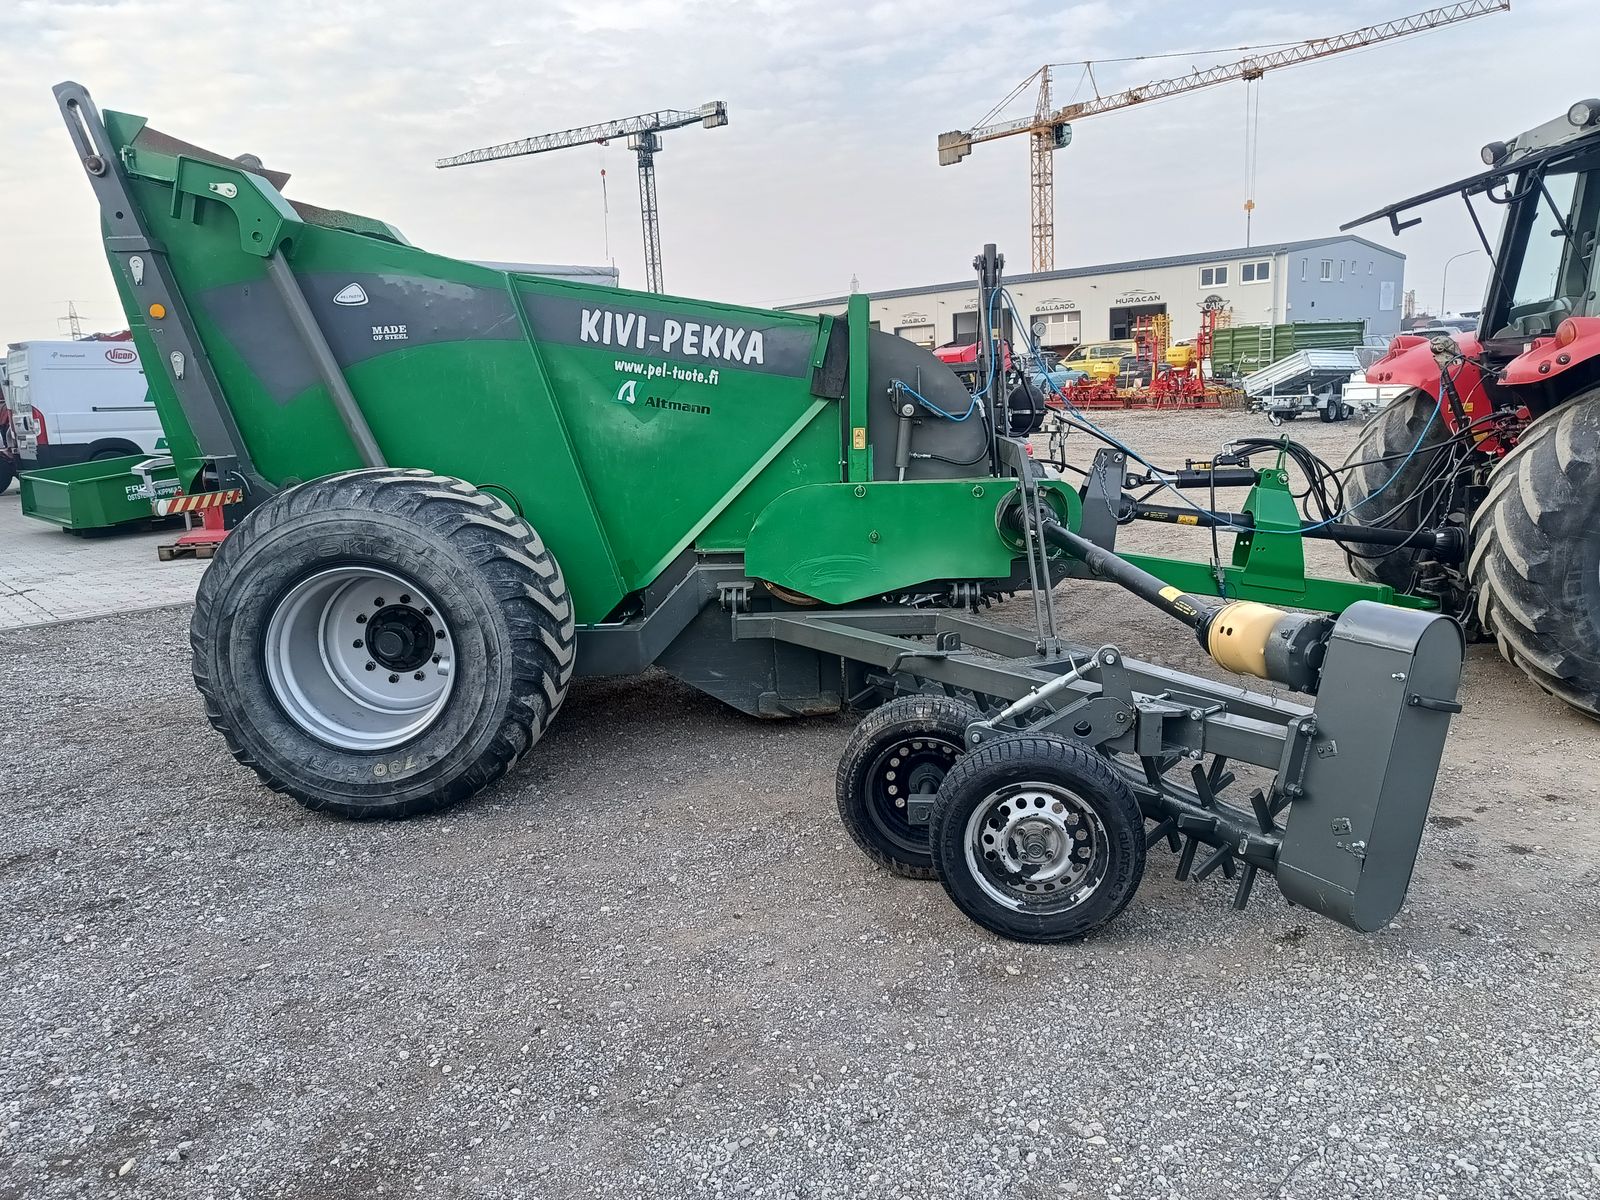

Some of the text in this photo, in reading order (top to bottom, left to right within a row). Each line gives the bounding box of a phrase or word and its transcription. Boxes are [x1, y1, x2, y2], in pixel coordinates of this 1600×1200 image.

[1115, 294, 1161, 305] HURACAN
[1035, 303, 1076, 313] GALLARDO
[901, 317, 926, 325] DIABLO
[371, 325, 407, 335] MADE
[580, 308, 765, 365] KIVI-PEKKA
[109, 348, 133, 360] Vicon
[614, 360, 720, 386] www.pel-tuote.fi
[644, 396, 711, 415] Altmann
